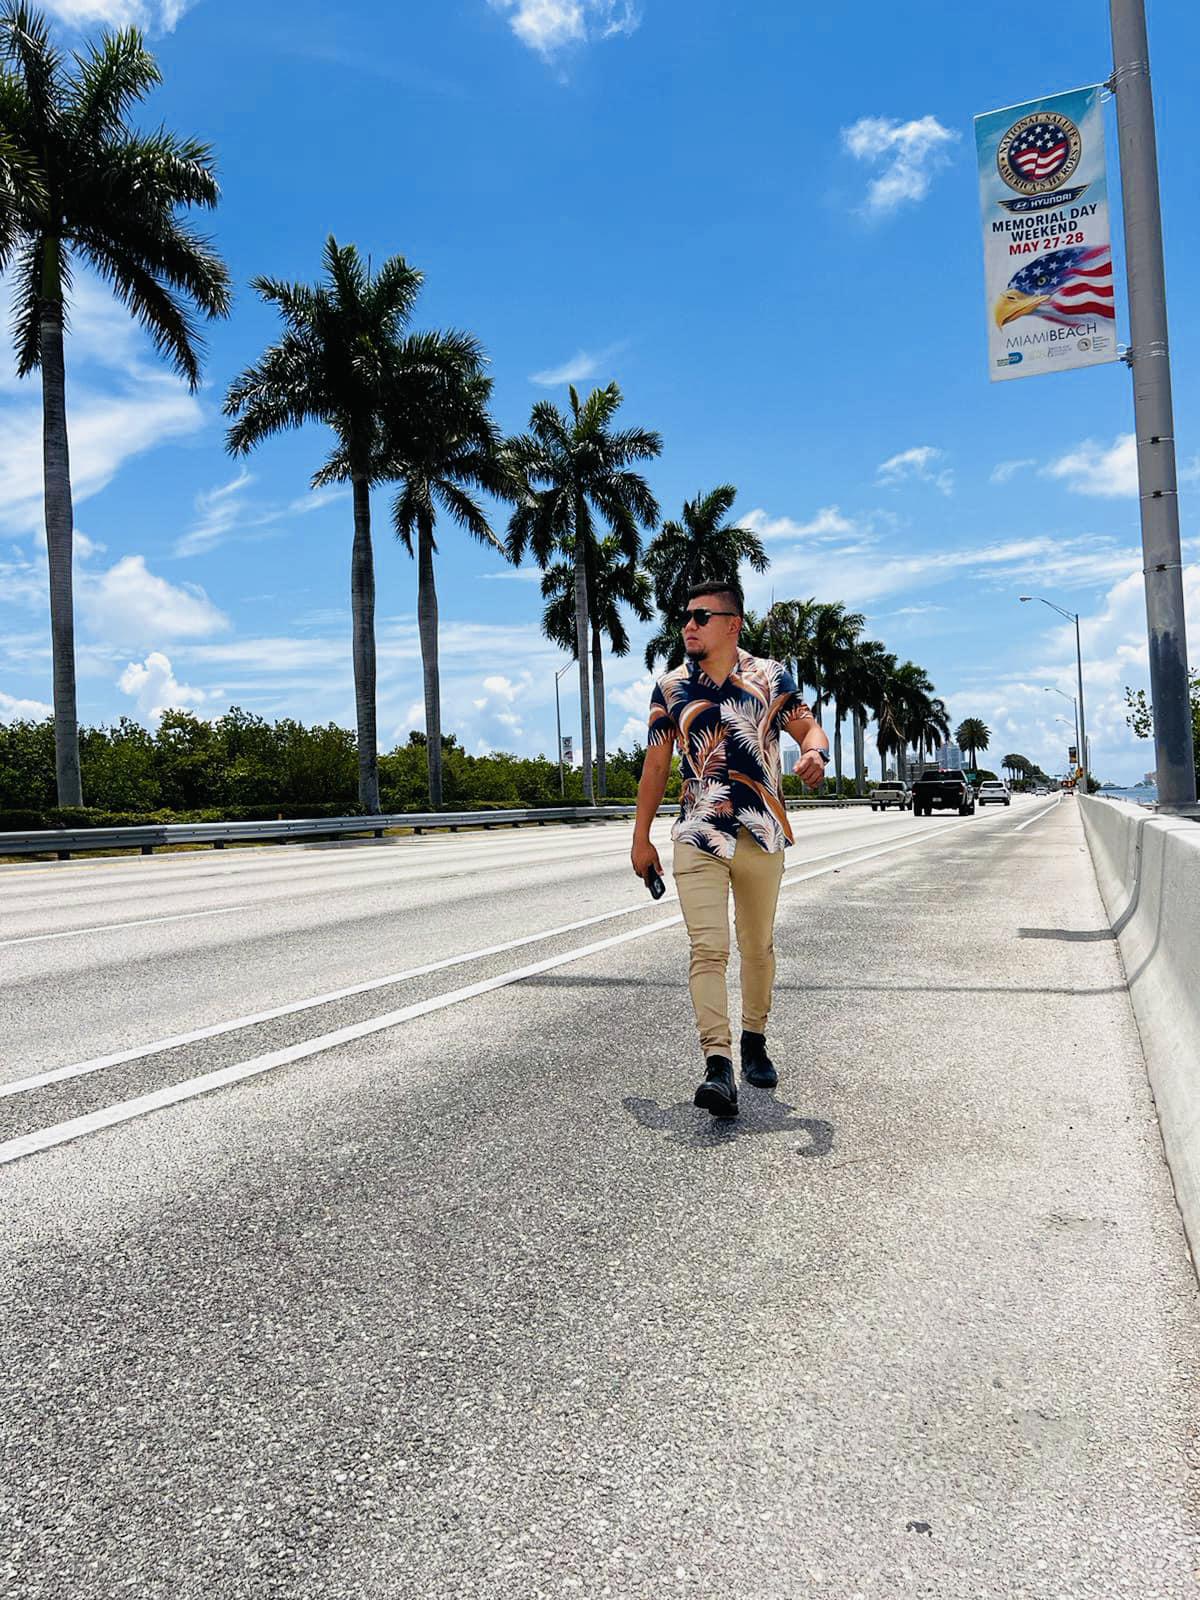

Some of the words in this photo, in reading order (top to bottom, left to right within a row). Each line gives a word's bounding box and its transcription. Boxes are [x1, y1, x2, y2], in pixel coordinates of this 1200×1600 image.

[999, 115, 1040, 154] NATIONAL
[1045, 114, 1078, 138] SALUTE
[1000, 163, 1047, 192] AMERICA'S
[1049, 149, 1079, 187] HEROES
[1030, 193, 1072, 208] HYUNDAI
[992, 211, 1067, 233] MEMORIAL
[1070, 203, 1098, 219] DAY
[1011, 220, 1078, 242] WEEKEND
[1009, 241, 1040, 256] MAY
[1043, 231, 1085, 250] 27-28
[1006, 322, 1097, 349] MIAMIBEACH
